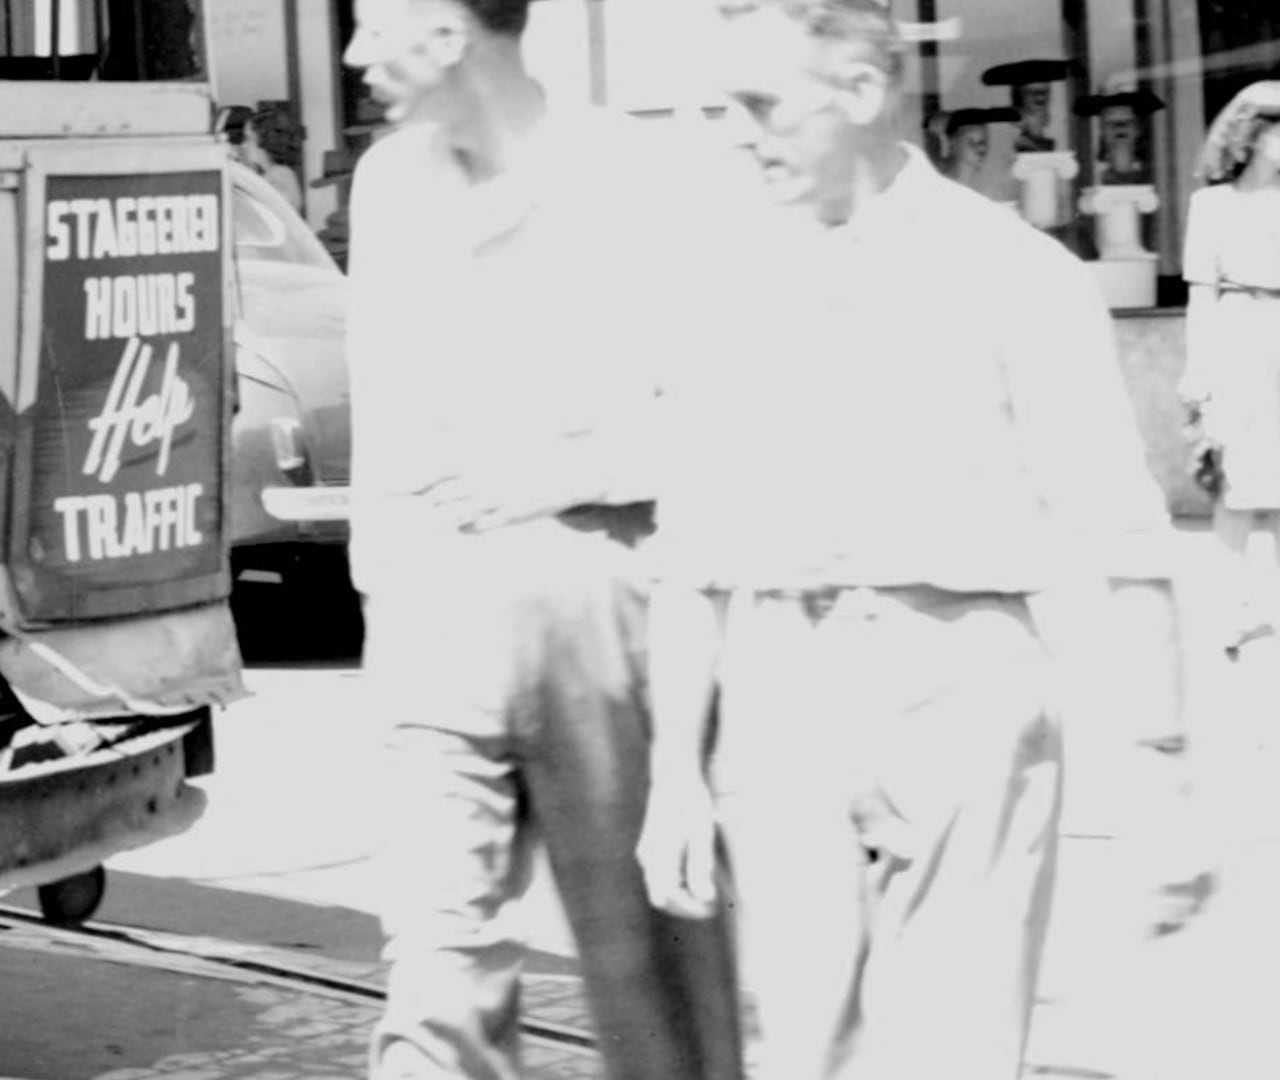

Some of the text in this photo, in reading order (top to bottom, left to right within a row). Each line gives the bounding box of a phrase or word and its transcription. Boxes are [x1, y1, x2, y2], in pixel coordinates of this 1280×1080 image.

[84, 272, 196, 340] HOURS
[82, 335, 196, 483] Help
[53, 483, 203, 562] TRAFFIC
